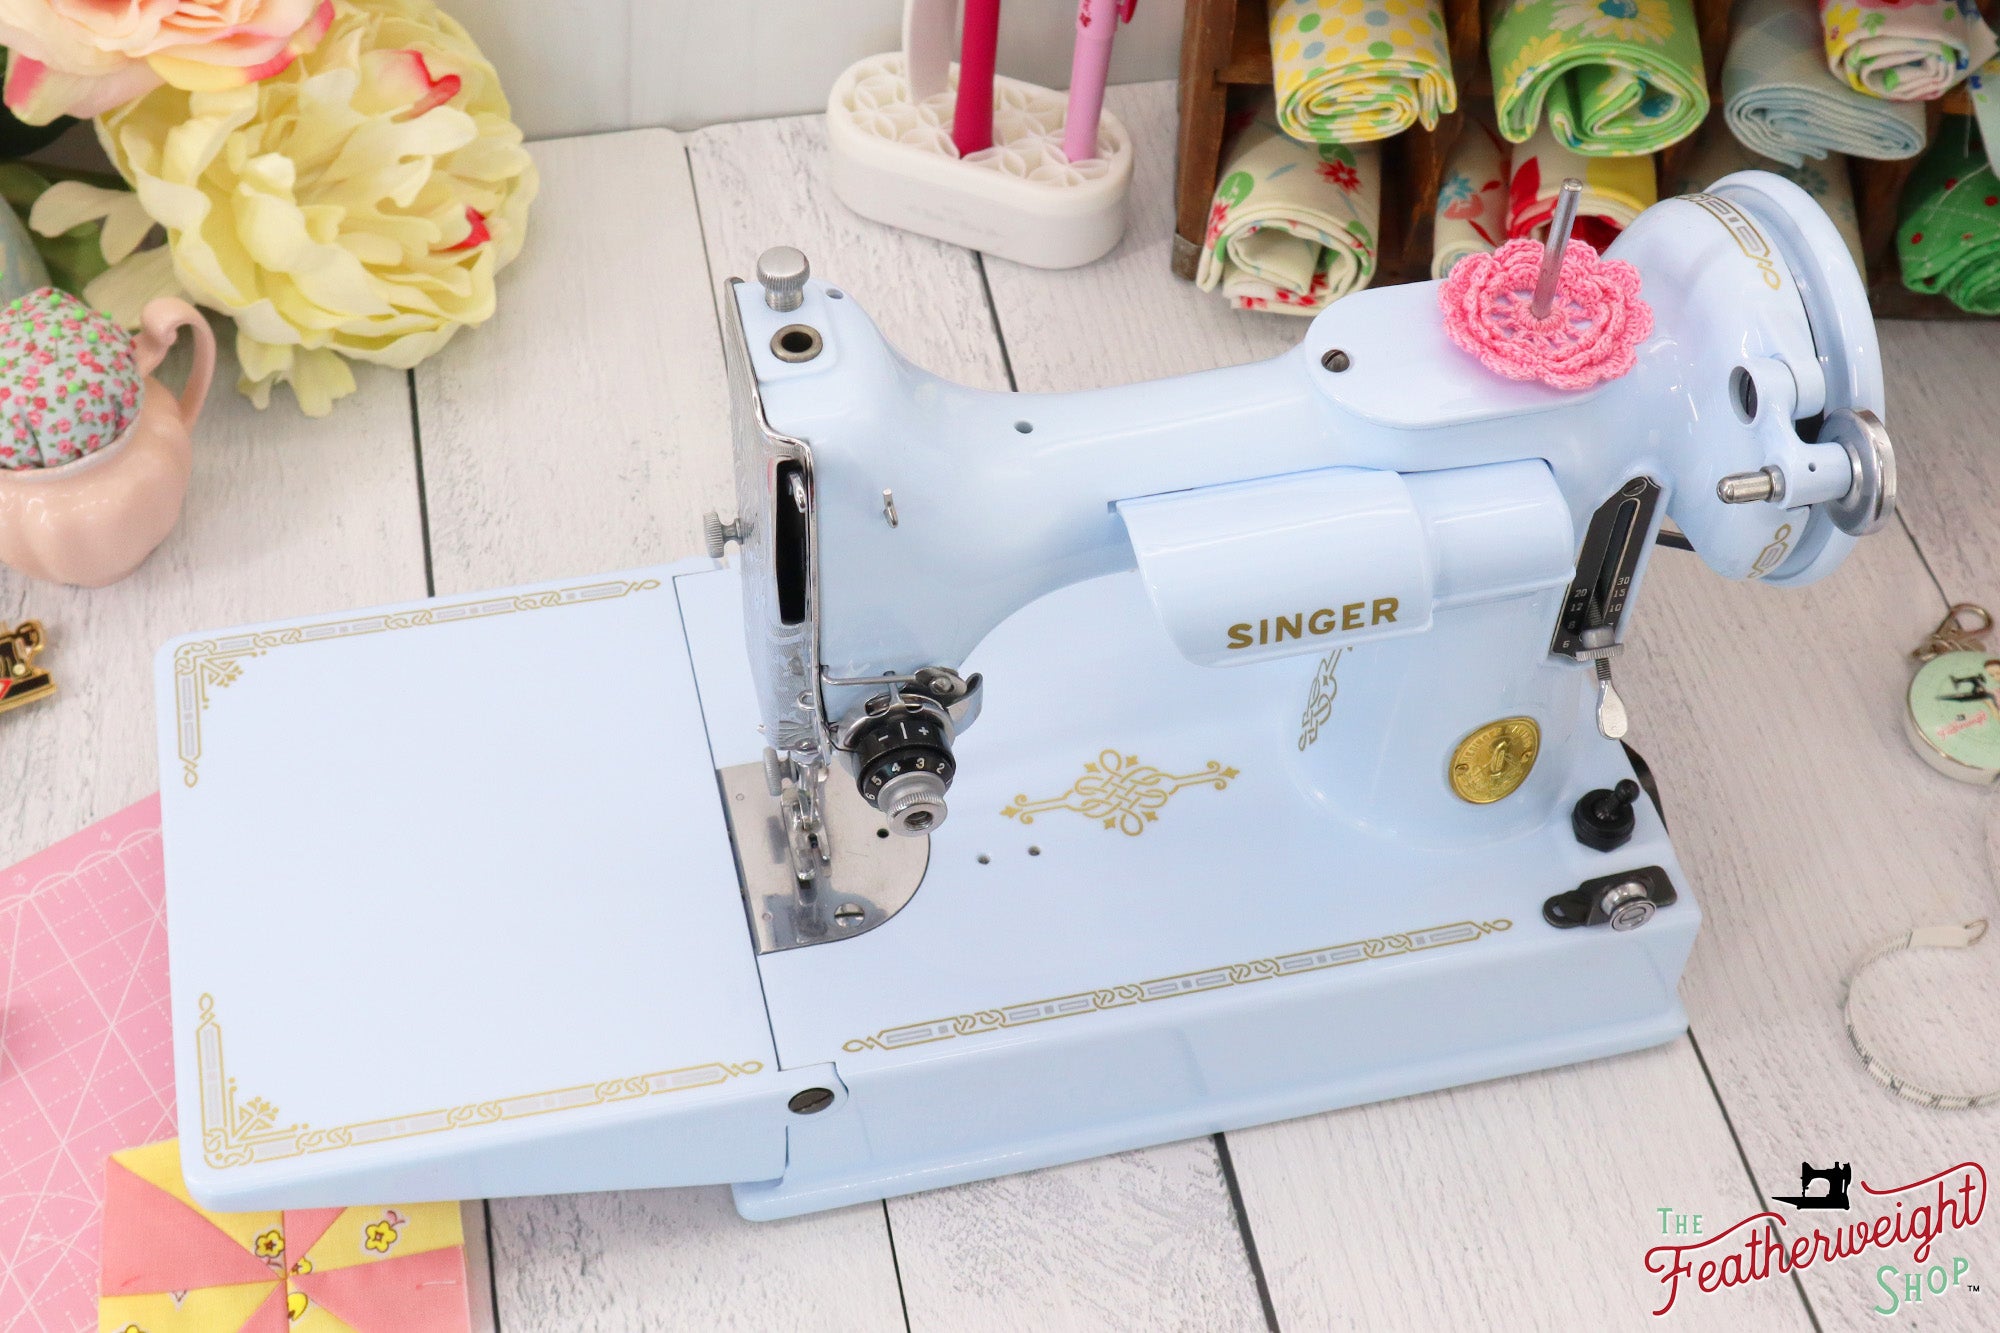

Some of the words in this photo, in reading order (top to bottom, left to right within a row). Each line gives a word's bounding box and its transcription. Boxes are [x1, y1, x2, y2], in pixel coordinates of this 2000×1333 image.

[1617, 577, 1630, 585] 30
[1575, 589, 1587, 597] 20
[1614, 589, 1625, 597] 15
[1571, 603, 1583, 611] 12
[1609, 604, 1622, 612] 10
[1227, 597, 1399, 649] SINGER
[871, 776, 882, 785] 5
[891, 762, 901, 772] 4
[915, 757, 925, 769] 3
[936, 763, 945, 774] 2
